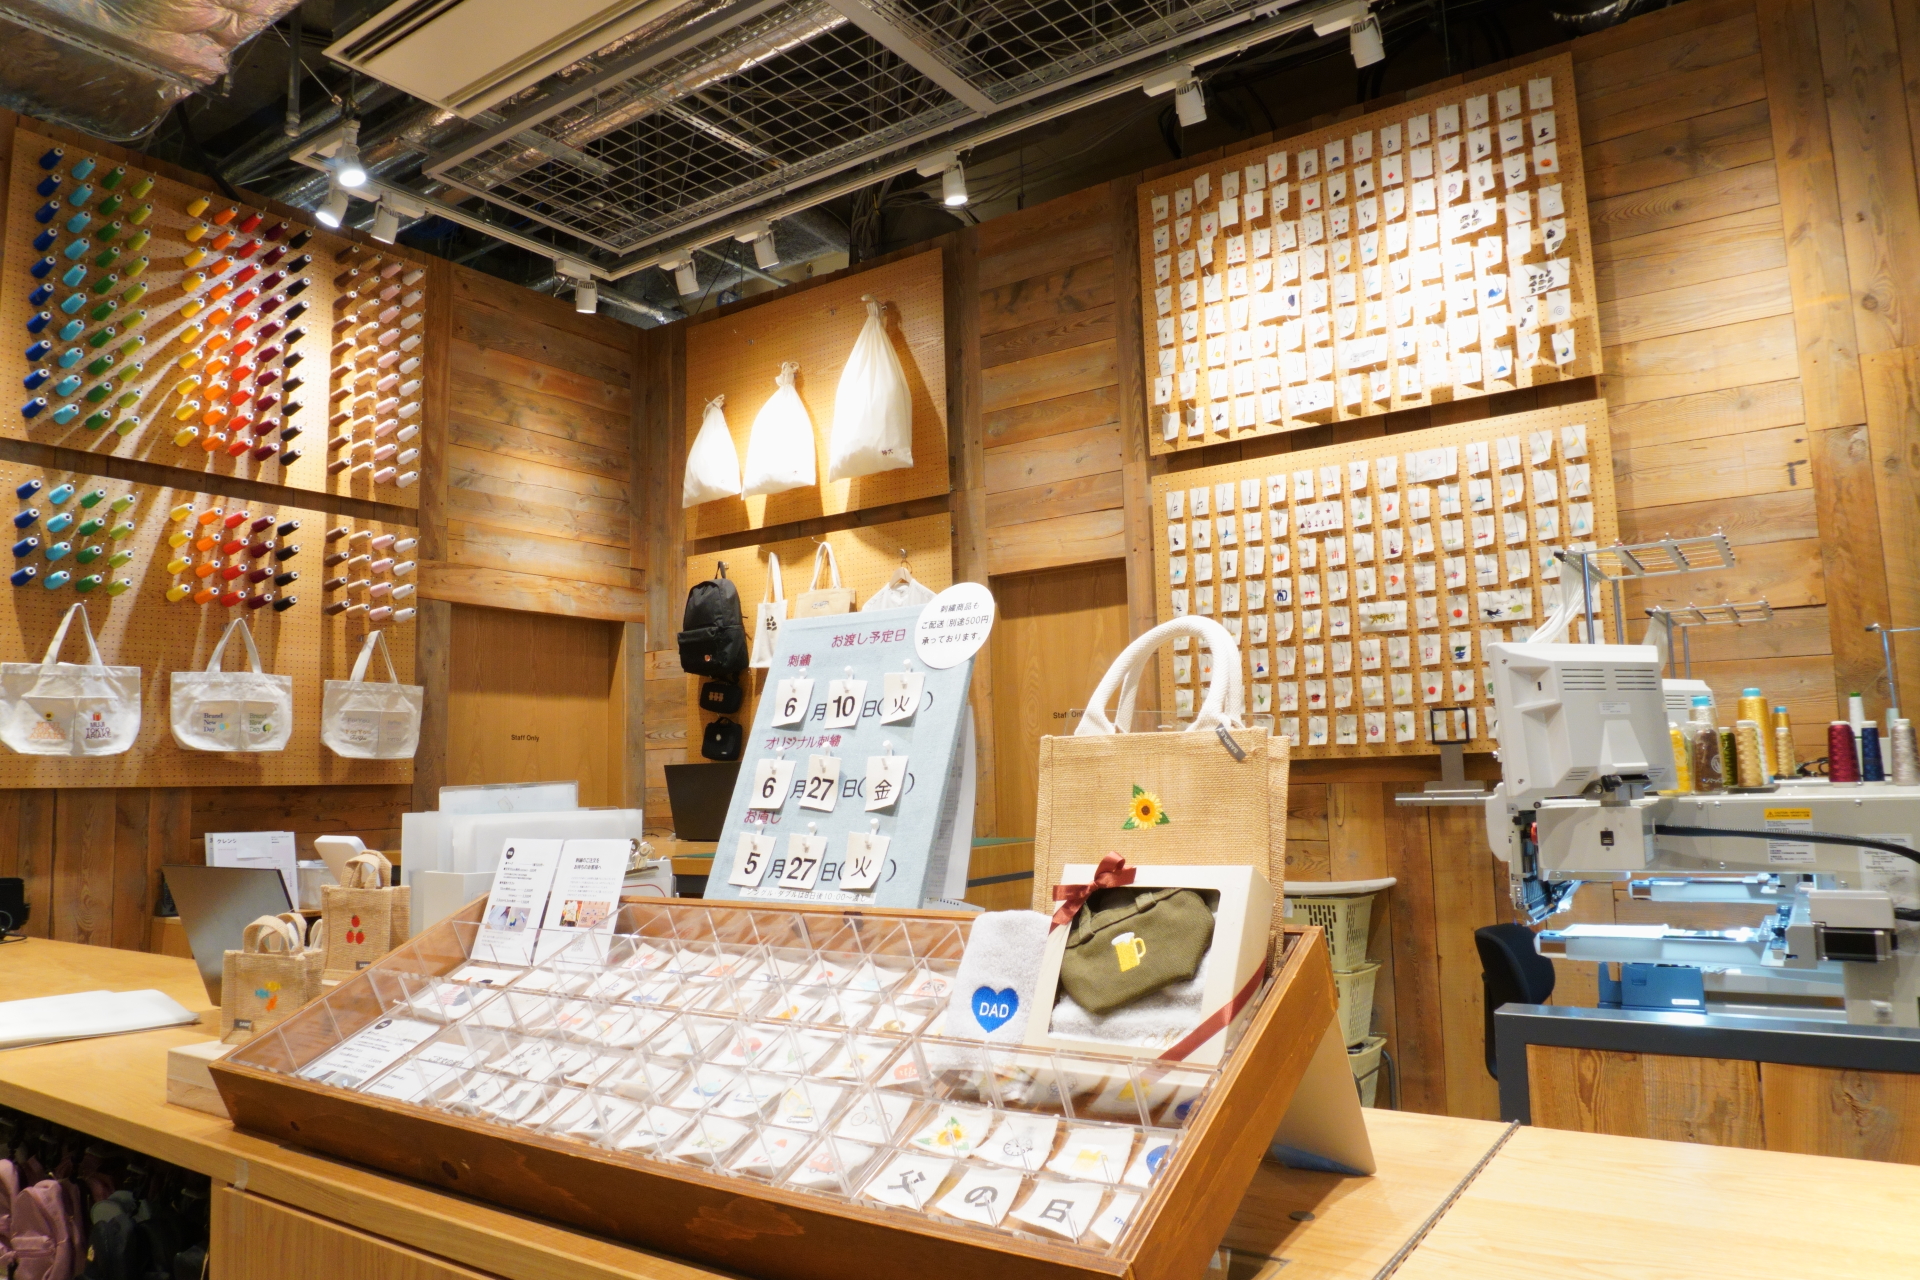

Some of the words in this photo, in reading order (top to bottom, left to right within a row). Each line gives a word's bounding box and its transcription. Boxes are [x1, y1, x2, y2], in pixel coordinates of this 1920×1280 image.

[831, 628, 906, 648] お渡し予定日
[1052, 711, 1068, 719] Staf
[511, 733, 525, 741] Staff
[526, 734, 540, 742] Only
[743, 810, 782, 824] お直し
[979, 1002, 1009, 1018] DAD
